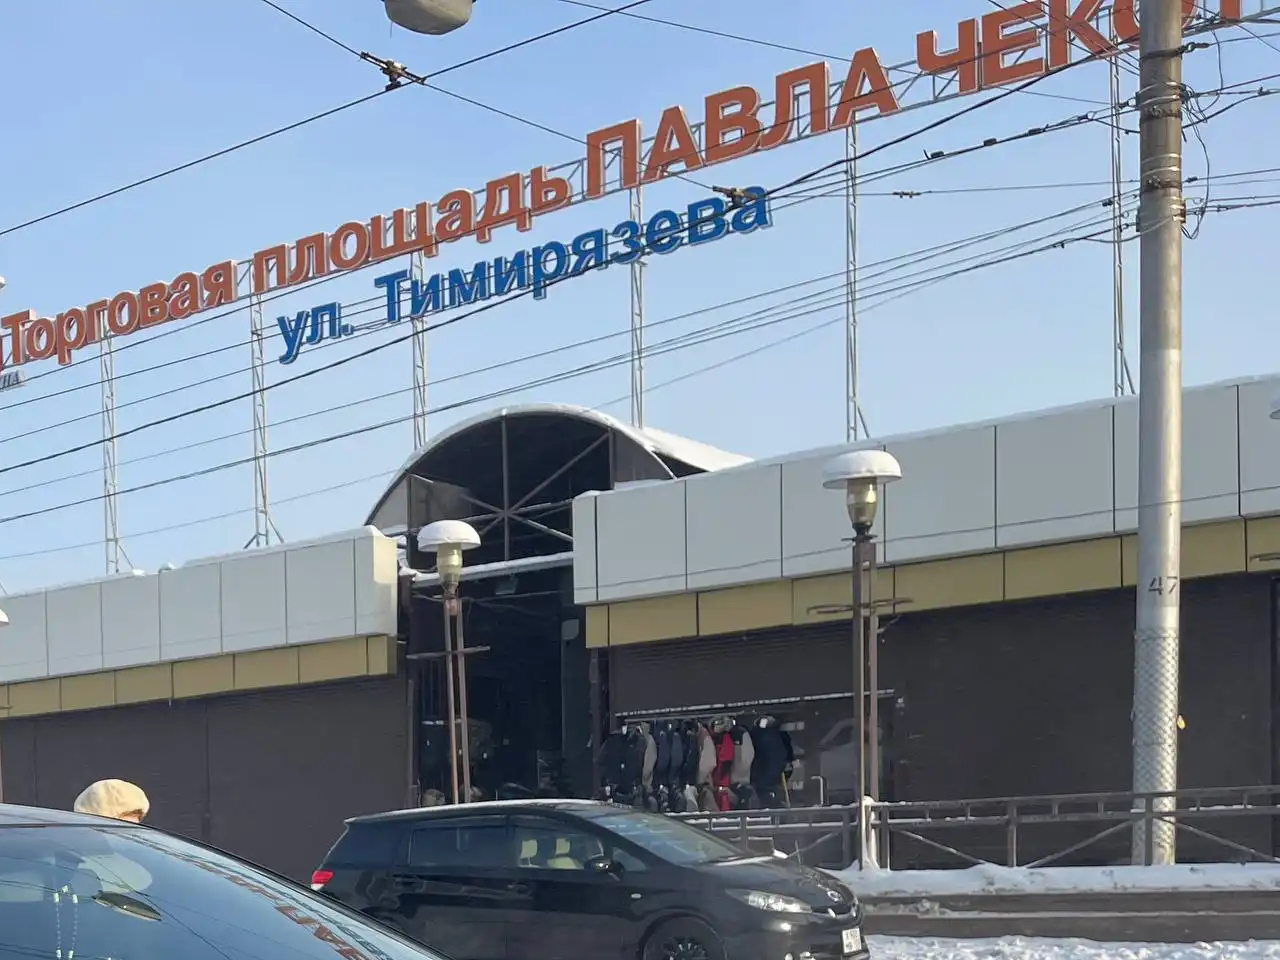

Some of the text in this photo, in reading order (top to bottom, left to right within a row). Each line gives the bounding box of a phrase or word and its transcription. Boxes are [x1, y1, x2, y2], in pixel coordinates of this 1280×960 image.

[0, 259, 240, 366] Торговая
[253, 165, 572, 294] площадь
[583, 46, 900, 201] ПАВЛА
[277, 185, 773, 366] ул. Тимирязева
